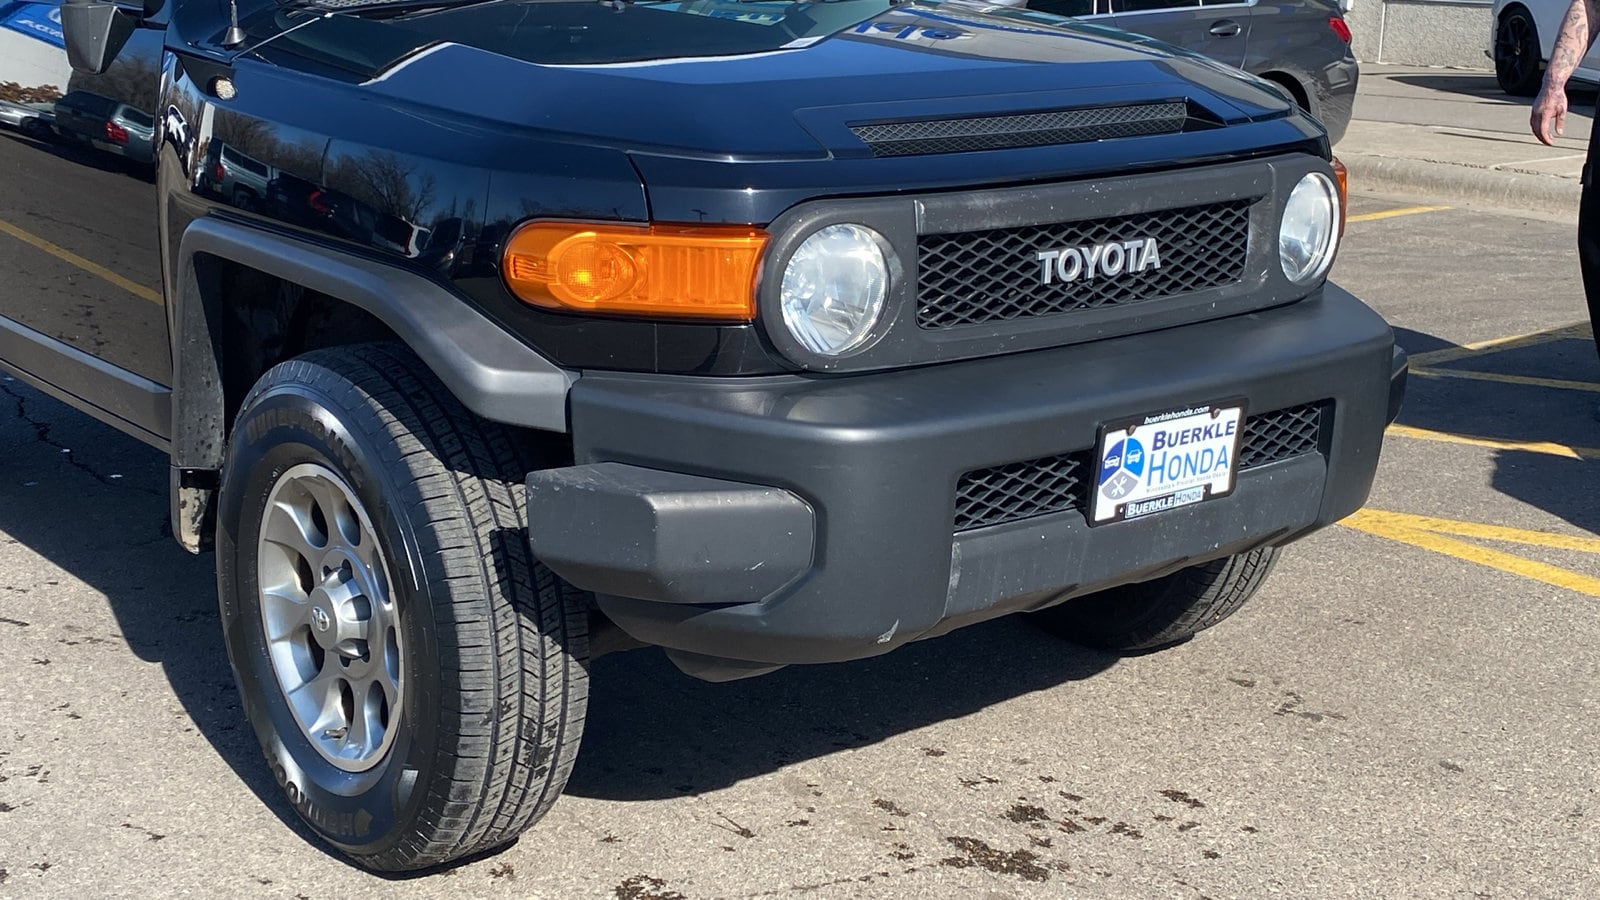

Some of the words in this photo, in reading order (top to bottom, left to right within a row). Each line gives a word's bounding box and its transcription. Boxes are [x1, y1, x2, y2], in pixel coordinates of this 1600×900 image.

[1038, 238, 1161, 284] TOYOTA
[1144, 406, 1210, 424] buerklehonda.com
[1152, 420, 1236, 451] BUERKLE
[1147, 445, 1229, 486] HONDA
[1127, 496, 1175, 516] BUERKLE
[1174, 490, 1202, 505] HONDA
